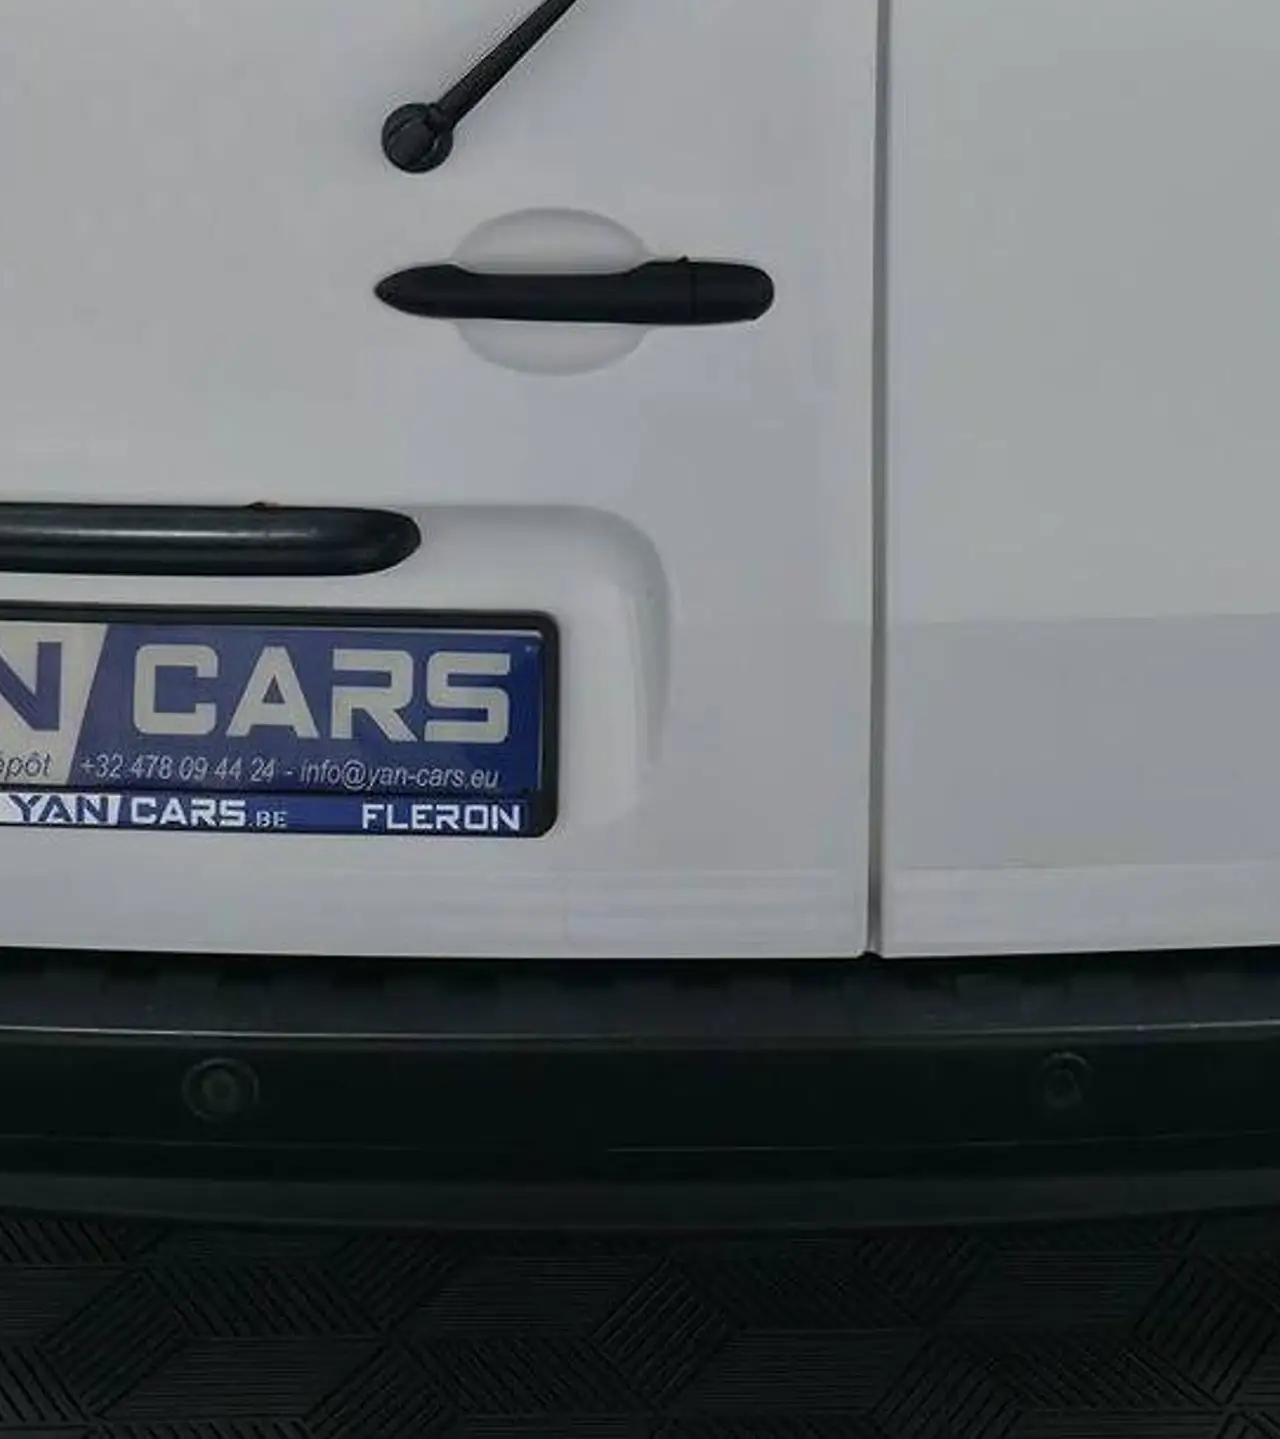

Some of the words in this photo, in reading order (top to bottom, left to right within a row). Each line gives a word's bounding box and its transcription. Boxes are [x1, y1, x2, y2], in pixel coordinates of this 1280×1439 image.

[133, 643, 511, 744] CARS
[79, 753, 121, 777] +32
[131, 754, 173, 779] 478
[178, 756, 208, 780] 09
[213, 756, 242, 781] 44
[250, 757, 276, 782] 24
[299, 760, 500, 792] info@yan-cars.eu
[10, 795, 109, 824] YAN
[362, 803, 521, 831] FLERON
